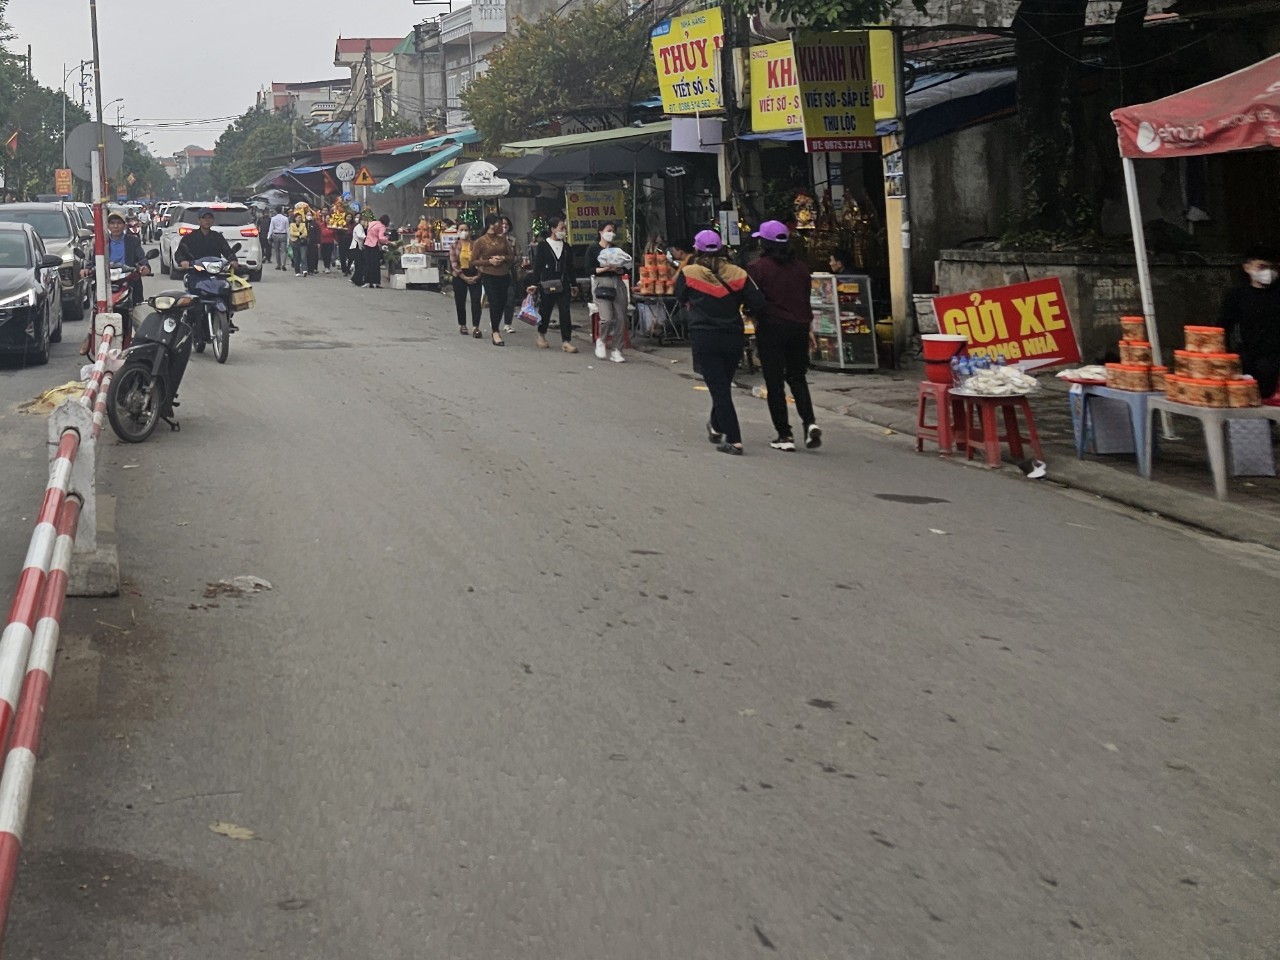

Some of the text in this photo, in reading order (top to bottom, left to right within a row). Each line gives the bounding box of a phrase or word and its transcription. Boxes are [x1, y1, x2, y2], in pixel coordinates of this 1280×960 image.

[659, 30, 709, 76] THỦY
[798, 40, 847, 82] KHÁNH
[672, 76, 691, 98] VIẾT
[805, 87, 822, 108] VIẾT
[759, 94, 774, 113] VIẾT
[1011, 291, 1066, 336] XE
[1022, 331, 1060, 357] NHÀ
